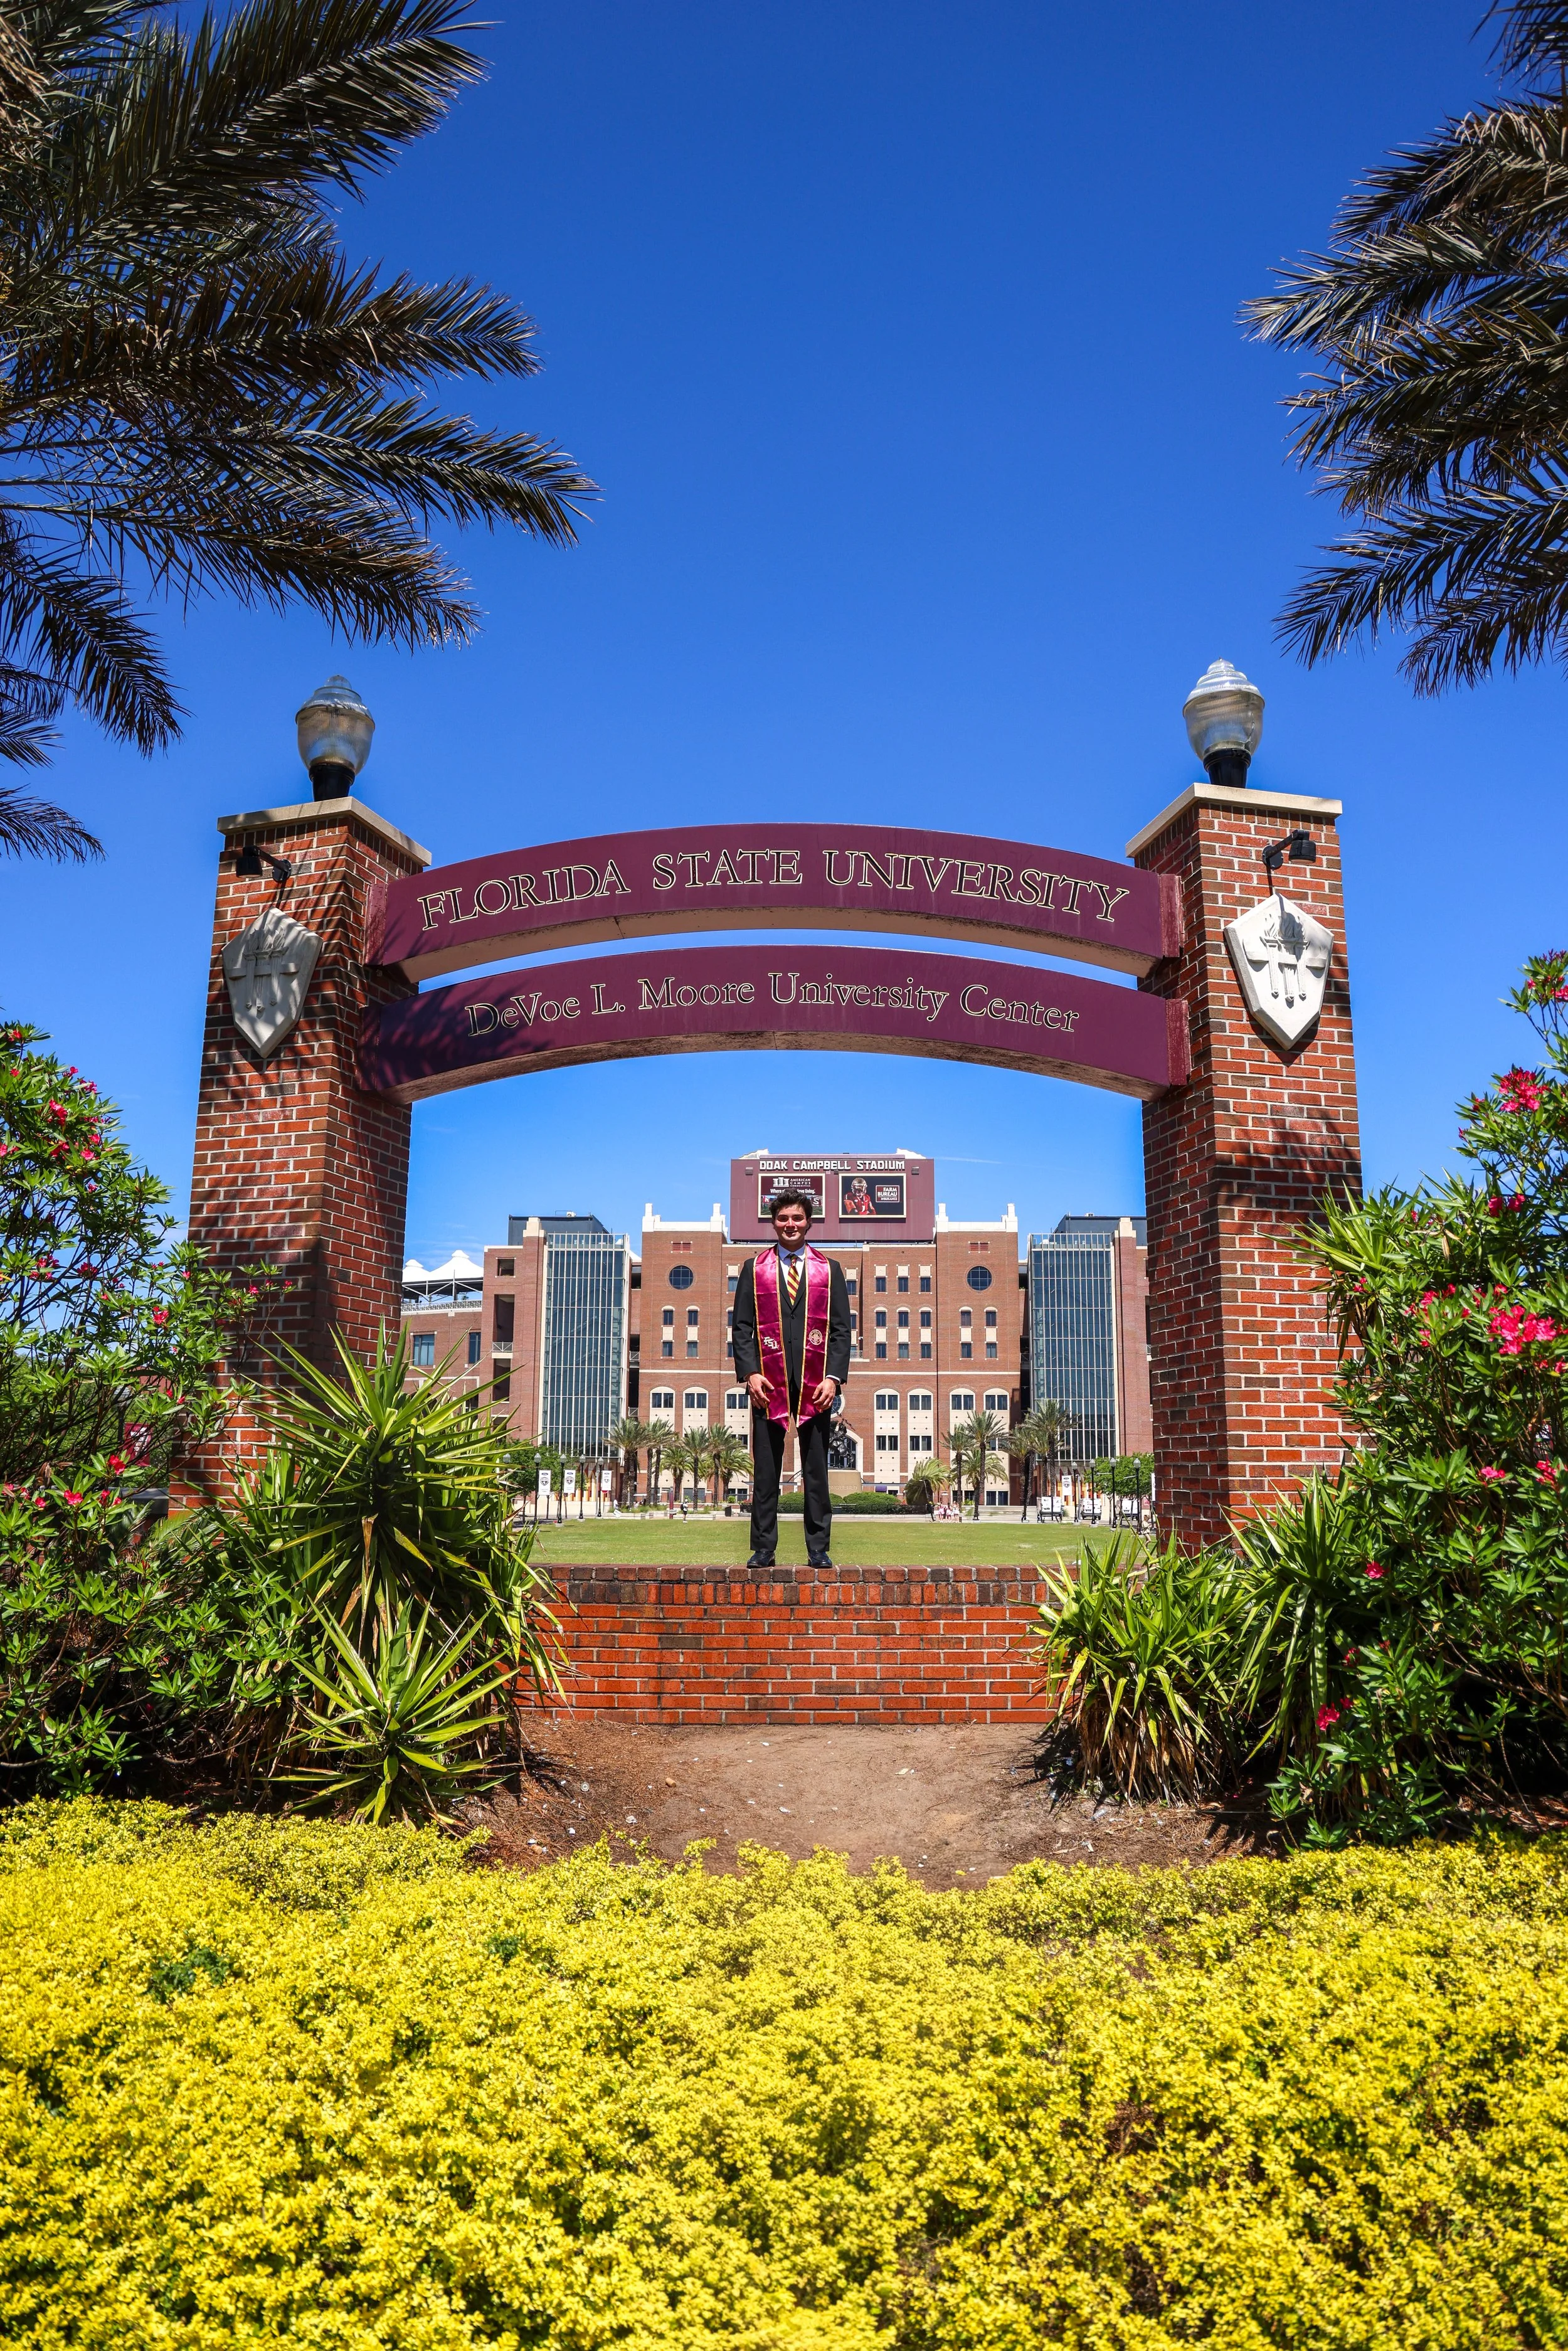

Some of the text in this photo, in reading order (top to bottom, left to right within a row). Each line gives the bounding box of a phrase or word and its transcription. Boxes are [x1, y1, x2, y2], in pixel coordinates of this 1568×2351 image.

[417, 849, 1130, 931] FLORIDA STATE UNIVERSITY
[465, 972, 1080, 1036] DeVoe L. Moore University Center
[760, 1160, 905, 1170] DOAK CAMPBELL STADIUM
[763, 1336, 779, 1349] FSU
